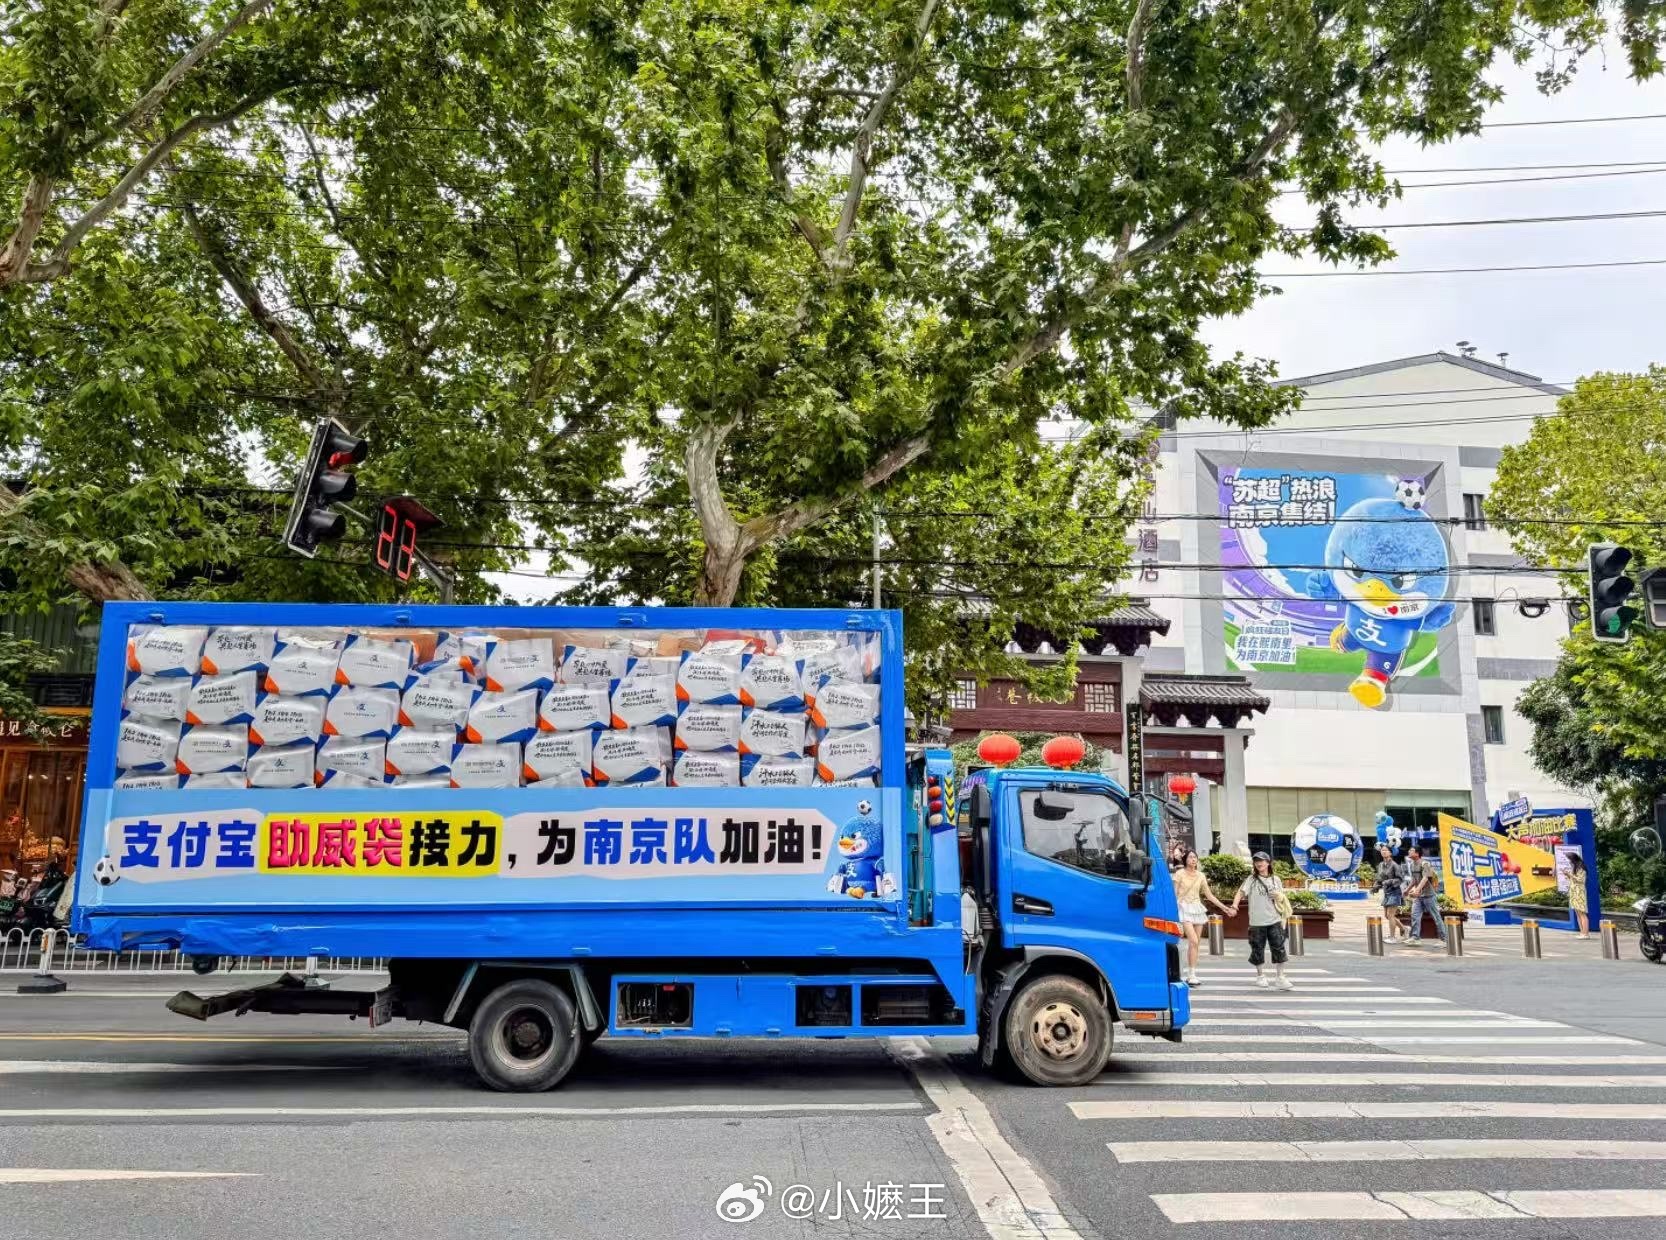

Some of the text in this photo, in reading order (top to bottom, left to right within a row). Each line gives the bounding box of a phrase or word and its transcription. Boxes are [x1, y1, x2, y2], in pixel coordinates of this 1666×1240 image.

[1224, 475, 1336, 502] “苏超”热浪
[120, 818, 822, 869] 支付宝助威袋接力，为南京队加油！
[1451, 842, 1505, 877] 碰一下
